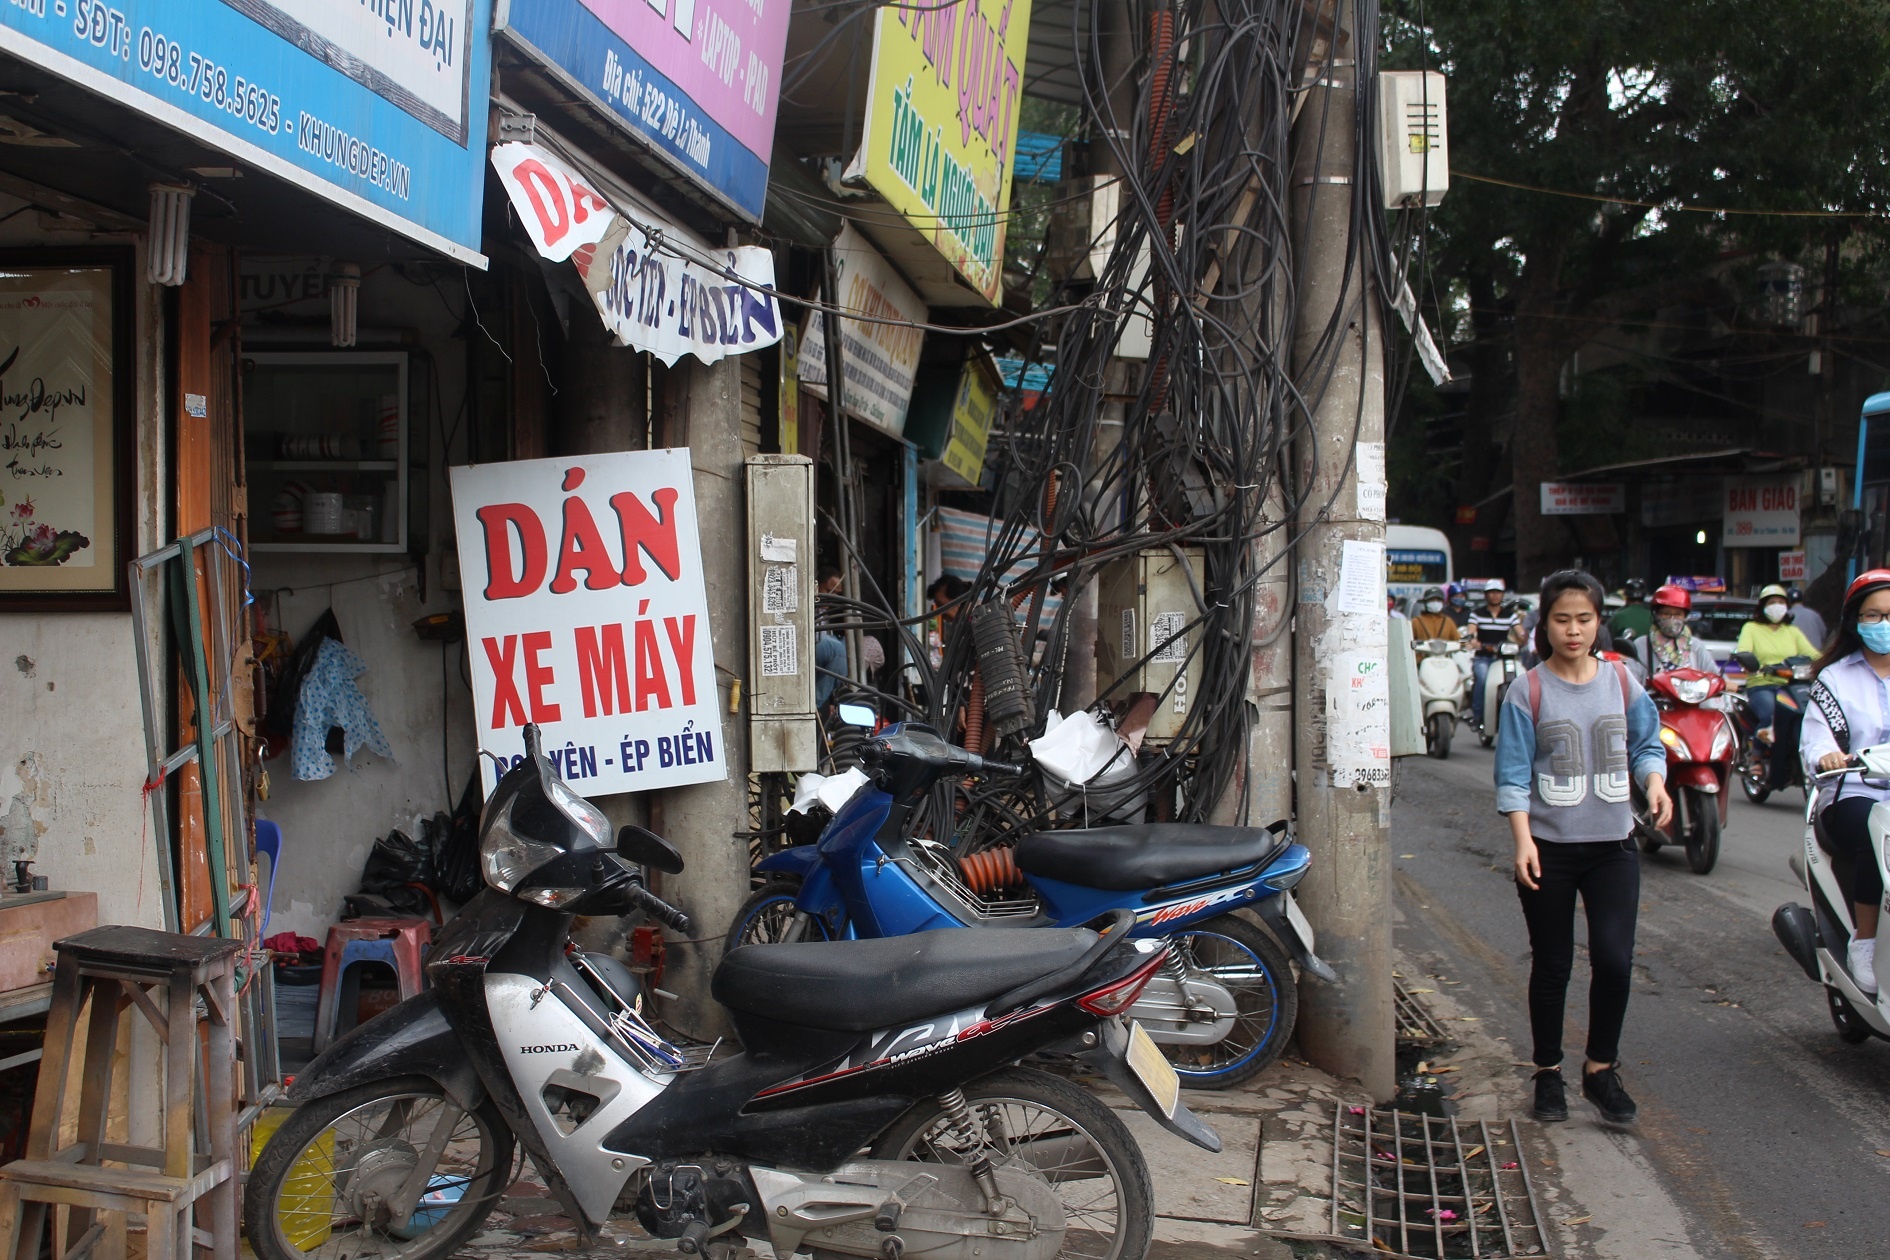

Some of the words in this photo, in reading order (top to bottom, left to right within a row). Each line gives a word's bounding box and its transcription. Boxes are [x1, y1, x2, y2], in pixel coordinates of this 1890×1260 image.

[75, 0, 131, 61] SĐT:
[139, 26, 280, 135] 098.758.5625
[299, 111, 410, 200] KHUNGDEP.VN
[641, 82, 666, 132] 522
[675, 108, 688, 153] La
[744, 50, 769, 117] IPAD
[921, 125, 942, 215] LÁ
[475, 467, 681, 601] DÁN
[481, 630, 562, 729] XE
[573, 599, 697, 719] MÁY
[762, 630, 773, 673] 0904.575.132
[620, 734, 650, 773] ÉP
[658, 719, 715, 768] BIỂN
[520, 1043, 580, 1055] HONDA
